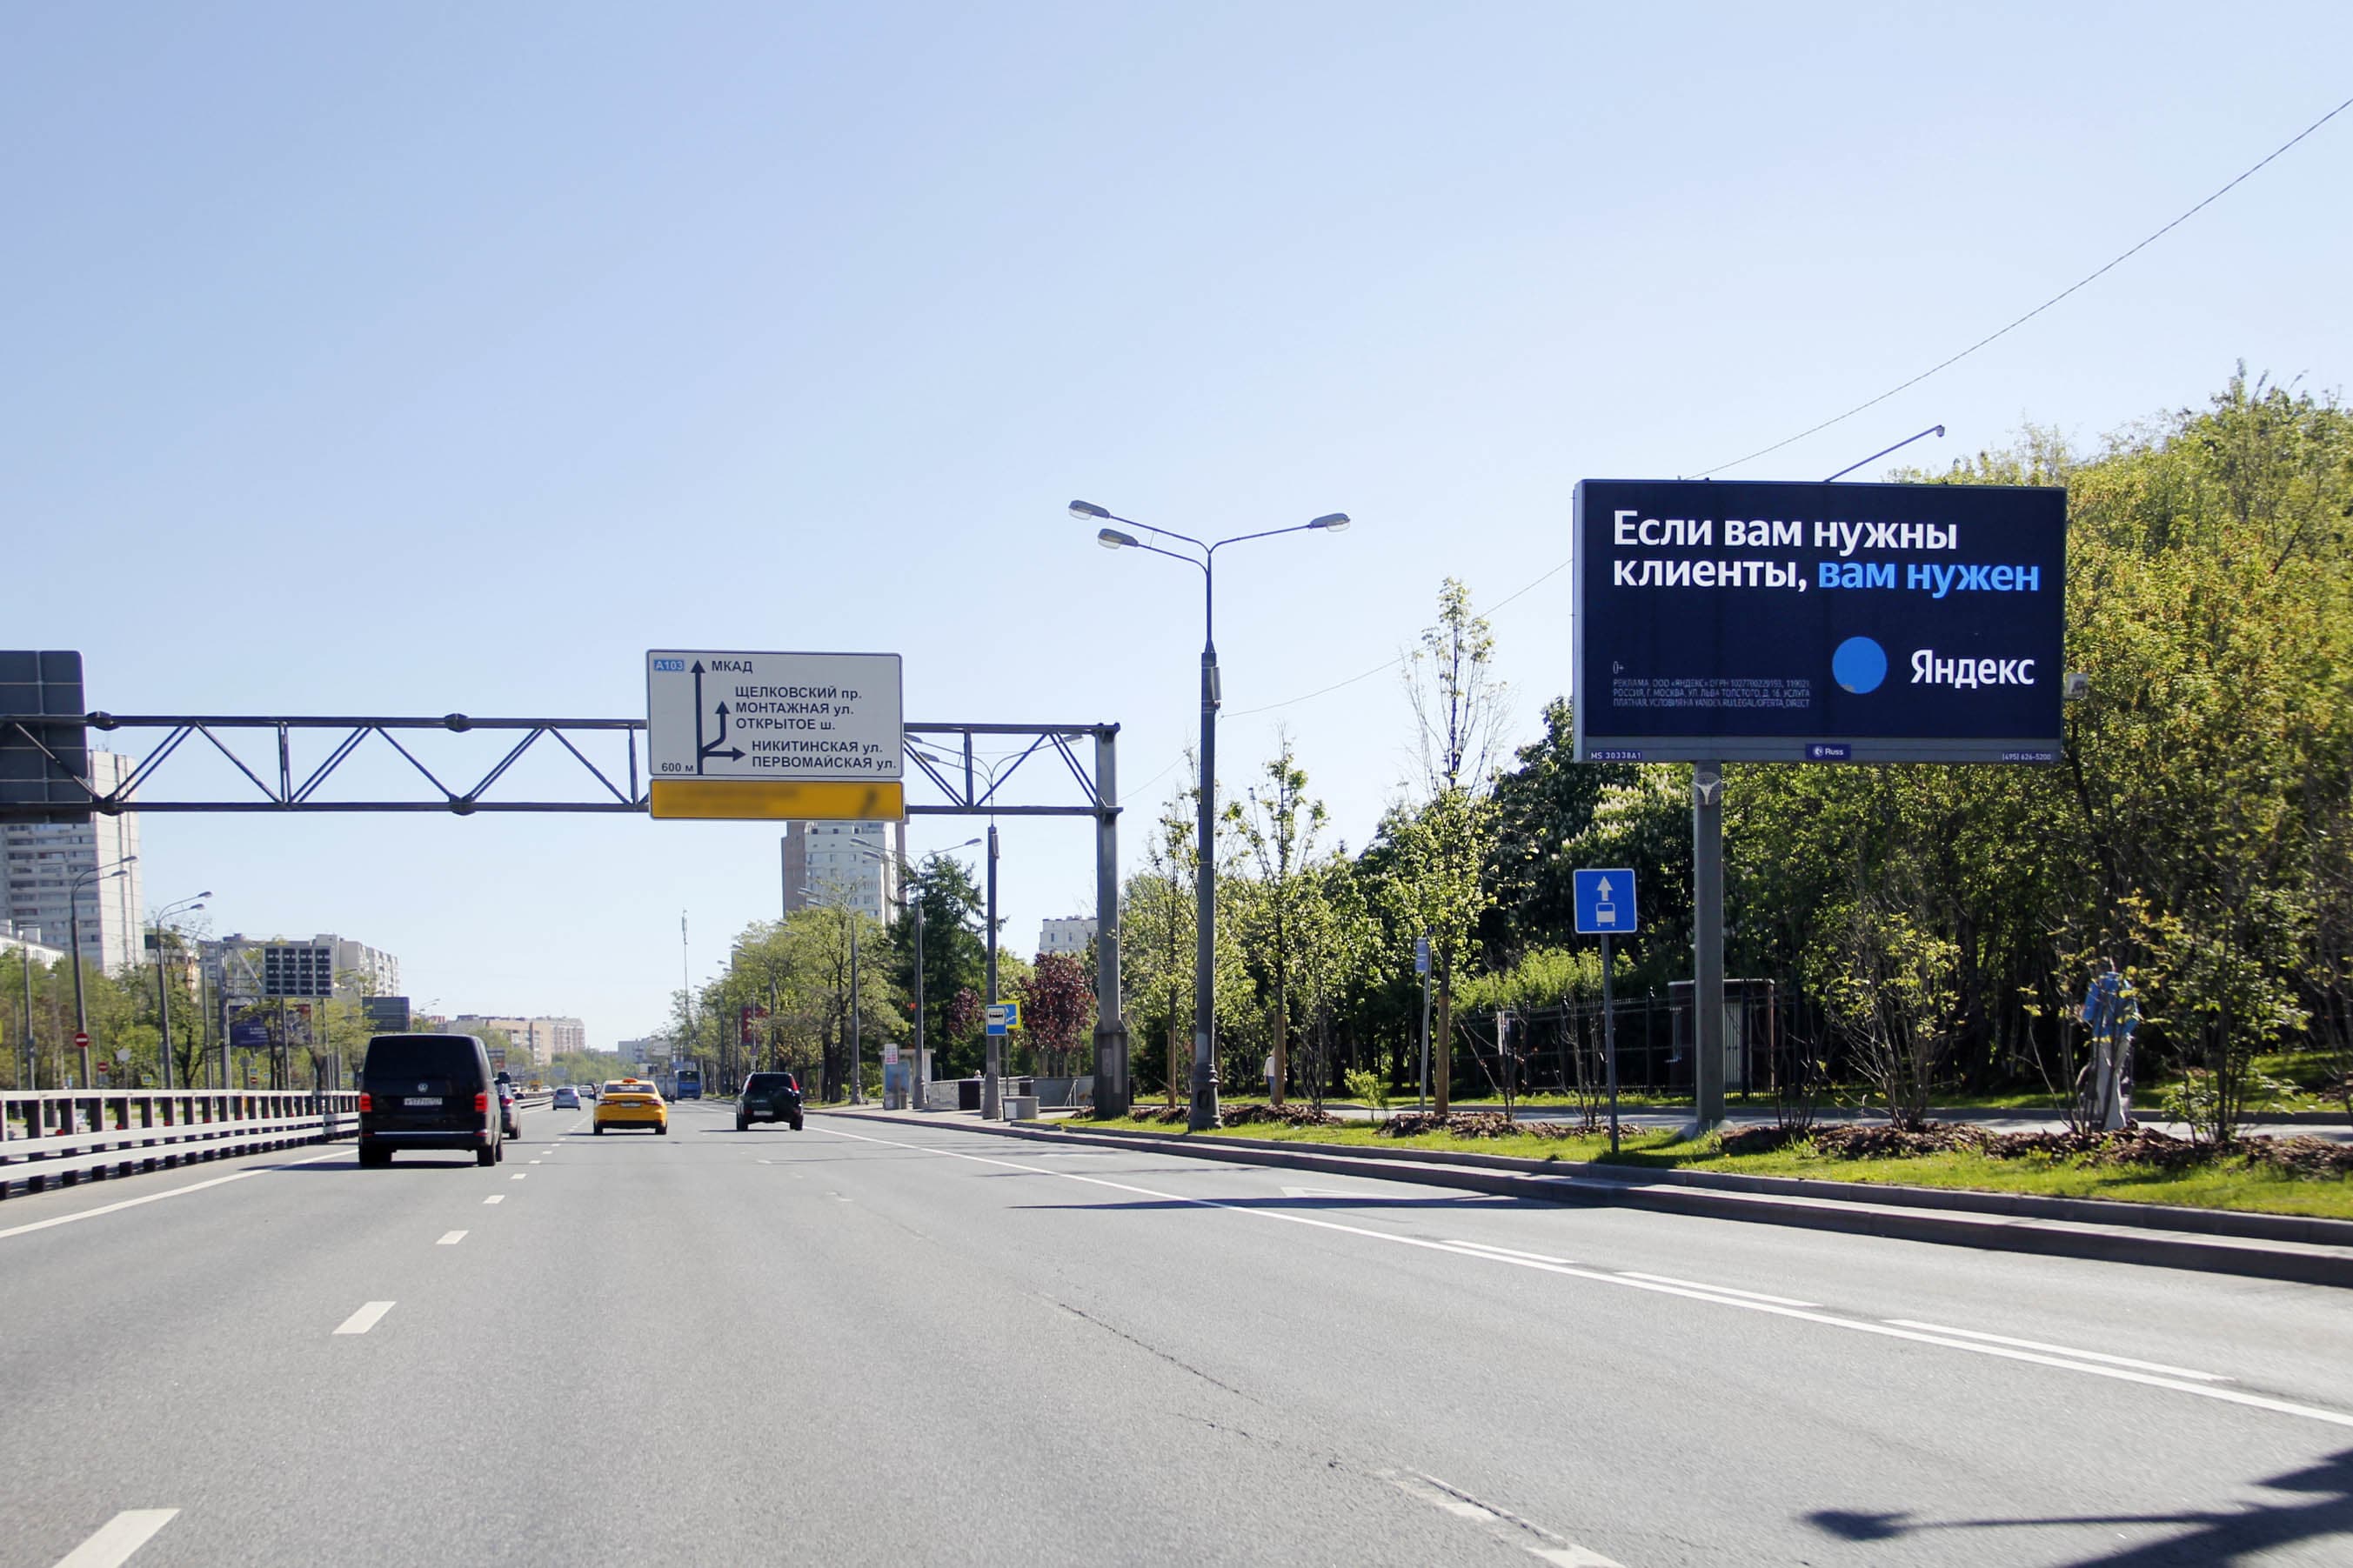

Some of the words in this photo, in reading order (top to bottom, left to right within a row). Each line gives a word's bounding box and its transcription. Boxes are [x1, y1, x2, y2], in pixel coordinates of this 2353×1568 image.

[1614, 510, 1712, 547] Если
[1725, 520, 1802, 547] вам
[1814, 521, 1957, 557] нужны
[1614, 559, 1808, 592] клиенты,
[1819, 562, 1895, 590] вам
[1908, 564, 2040, 598] нужен
[712, 660, 753, 674] МКАД
[1910, 650, 2035, 689] Яндекс
[735, 685, 837, 699] ЩЕЛКОВСКИЙ
[841, 690, 862, 701] пр.
[736, 702, 830, 714] МОНТАЖНАЯ
[833, 705, 854, 717] ул.
[736, 717, 816, 730] ОТКРЫТОЕ
[820, 721, 836, 731] ш.
[752, 740, 859, 752] НИКИТИНСКАЯ
[862, 744, 883, 755] ул.
[661, 762, 682, 772] 600
[752, 755, 872, 769] ПЕРВОМАЙСКАЯ
[876, 759, 897, 771] ул.
